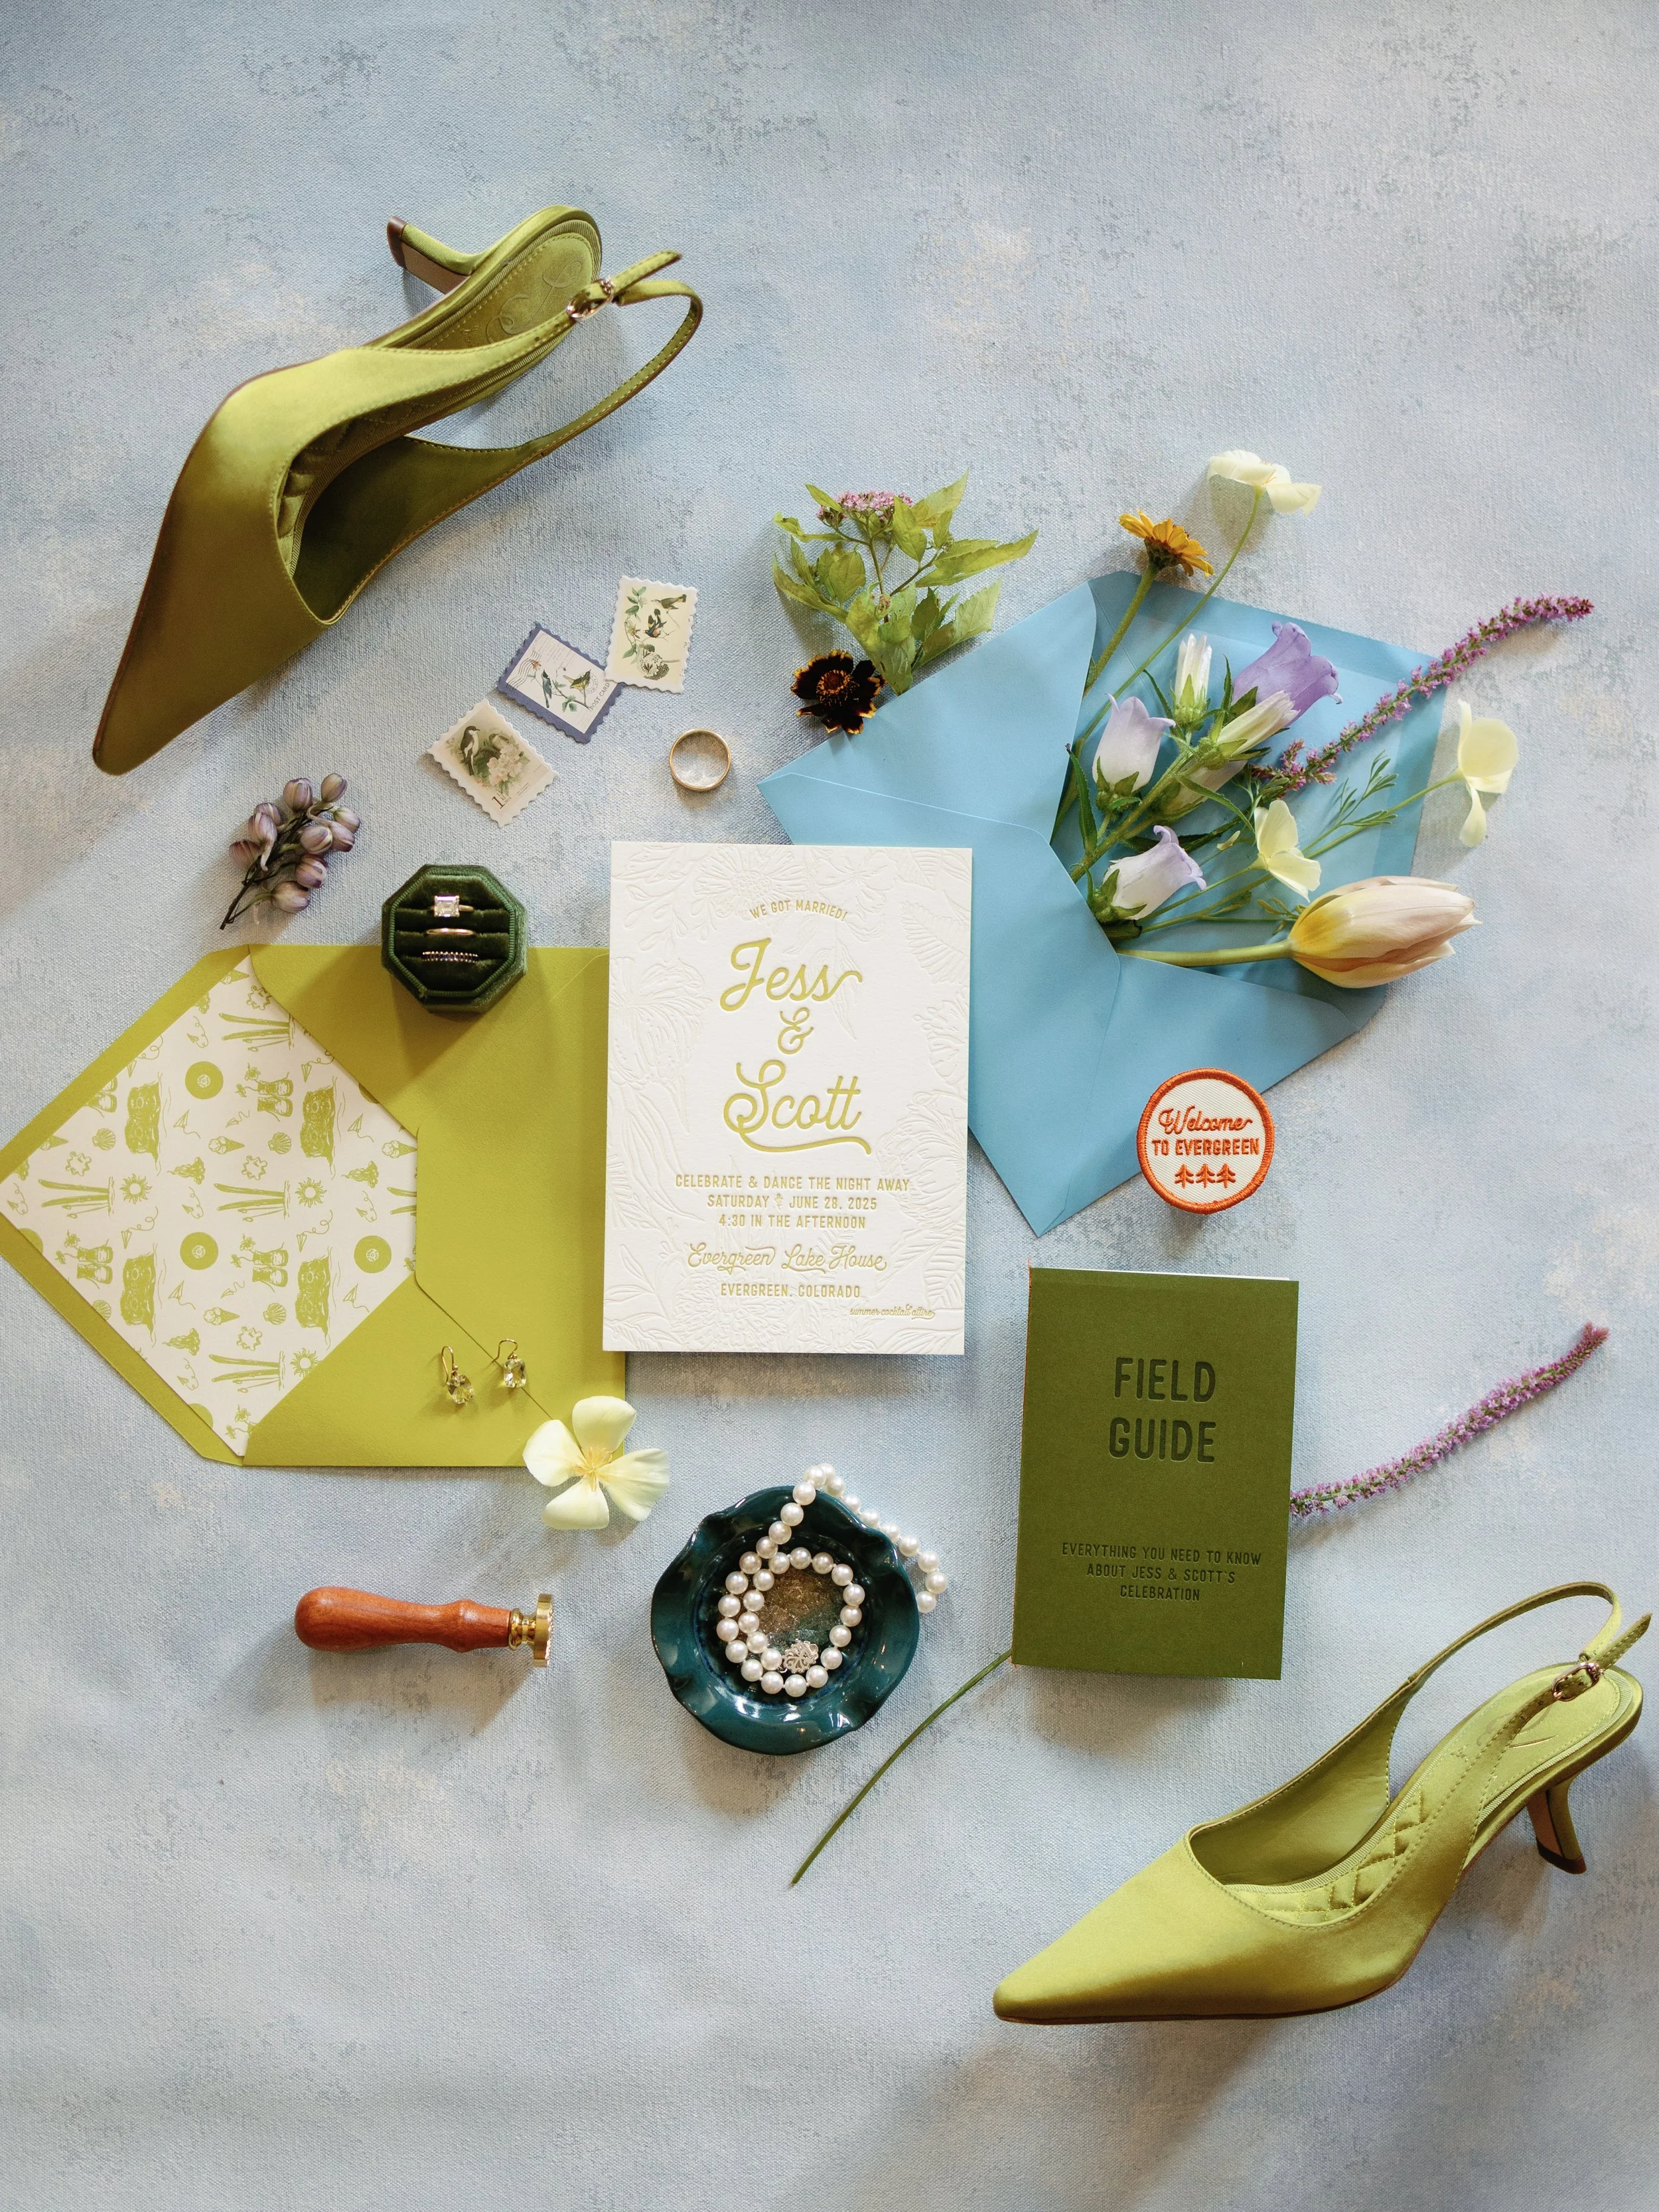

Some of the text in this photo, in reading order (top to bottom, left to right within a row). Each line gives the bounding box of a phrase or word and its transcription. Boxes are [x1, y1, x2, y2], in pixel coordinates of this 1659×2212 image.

[589, 682, 611, 711] POST CARD
[749, 899, 849, 921] WE GOT MARRIED!
[719, 937, 863, 1011] Jess
[777, 1007, 814, 1055] &
[723, 1059, 871, 1155] Scott
[1158, 1104, 1254, 1135] Welcome
[1151, 1137, 1260, 1156] TO EVERGREEN
[675, 1174, 910, 1192] CELEBRATE & DANCE THE NIGHT AWAY
[707, 1195, 770, 1208] SATURDAY
[788, 1196, 819, 1209] JUNE
[847, 1197, 878, 1211] 2025
[718, 1214, 867, 1229] 4:30 IN THE AFTERNOON
[687, 1242, 888, 1276] Evergreen Lake House
[798, 1284, 861, 1299] COLORADO
[881, 1303, 912, 1316] cocktail
[911, 1306, 936, 1320] attire
[1114, 1357, 1216, 1403] FIELD
[1109, 1417, 1217, 1463] GUIDE
[1062, 1542, 1262, 1566] EVERYTHING YOU NEED TO KNOW
[1087, 1563, 1236, 1584] ABOUT JESS & SCOTT'S
[1119, 1585, 1200, 1601] CELEBRATION
